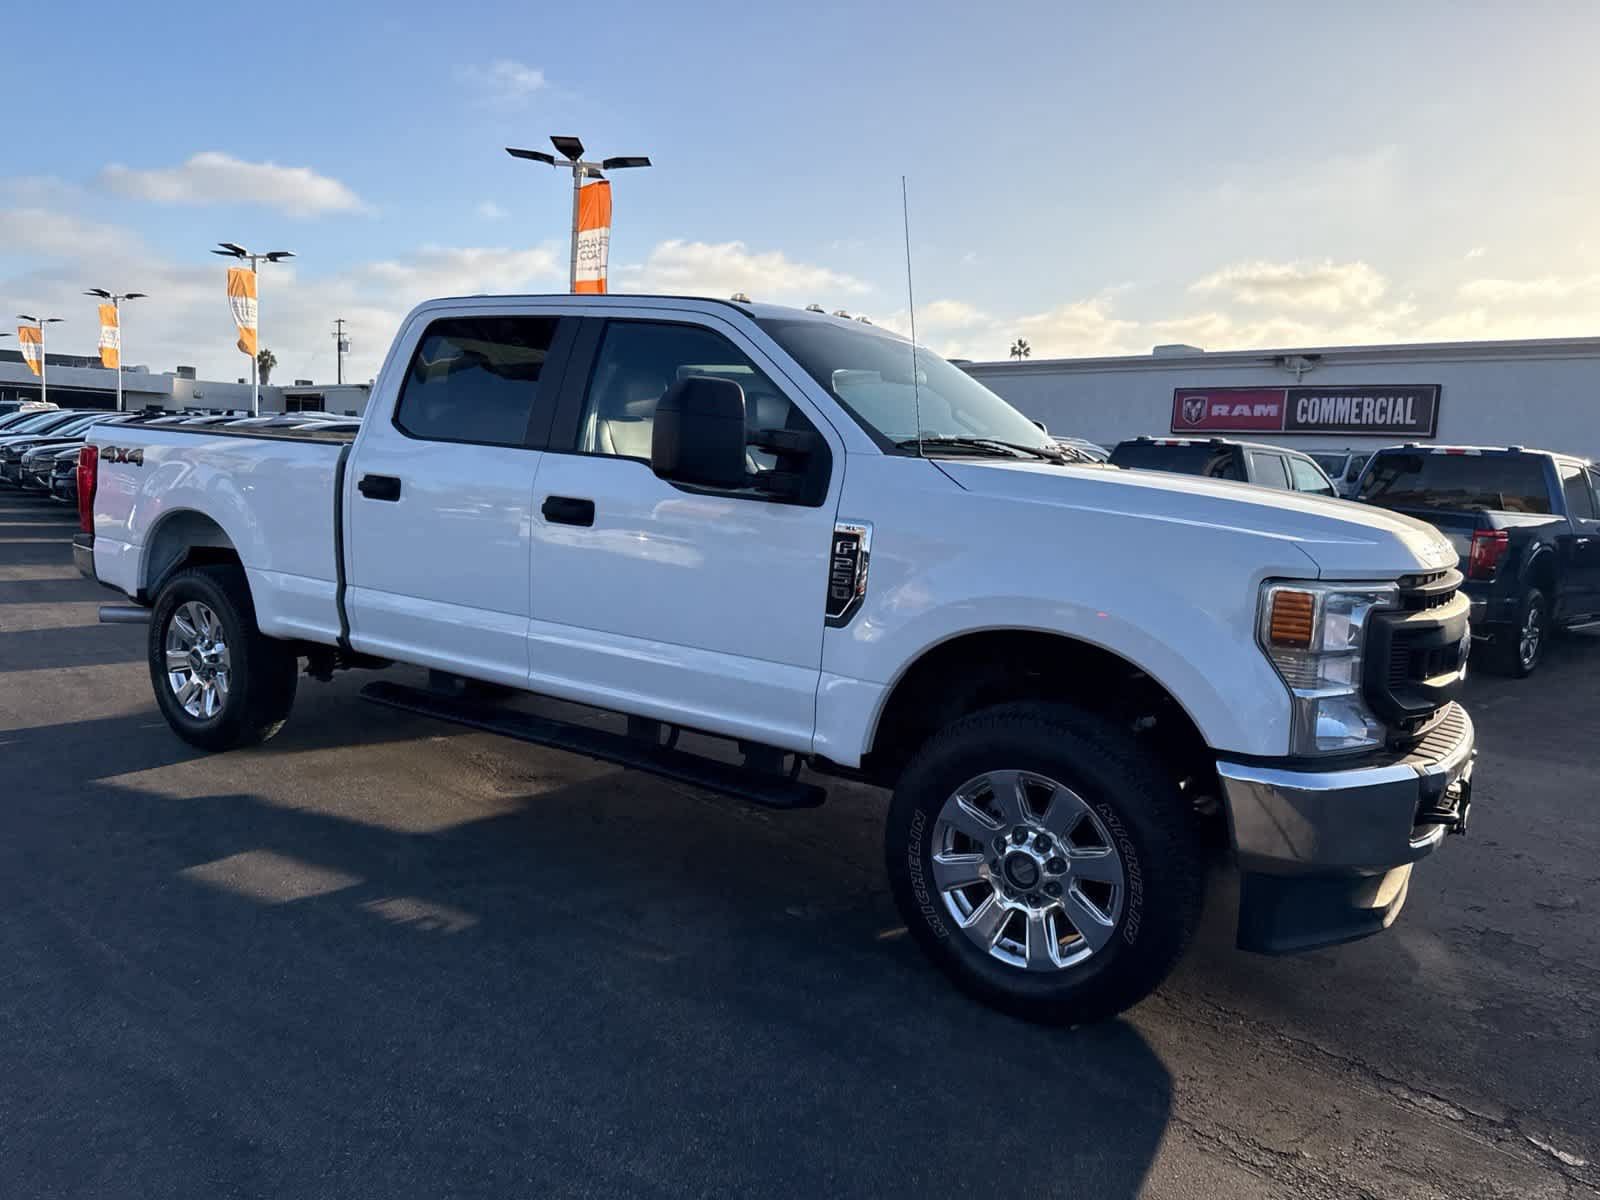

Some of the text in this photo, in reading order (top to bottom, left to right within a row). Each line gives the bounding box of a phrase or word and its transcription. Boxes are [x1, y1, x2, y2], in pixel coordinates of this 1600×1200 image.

[1211, 396, 1417, 425] RAM COMMERCIAL
[905, 808, 950, 940] MICHELIN
[1096, 802, 1144, 945] MICHELIN
